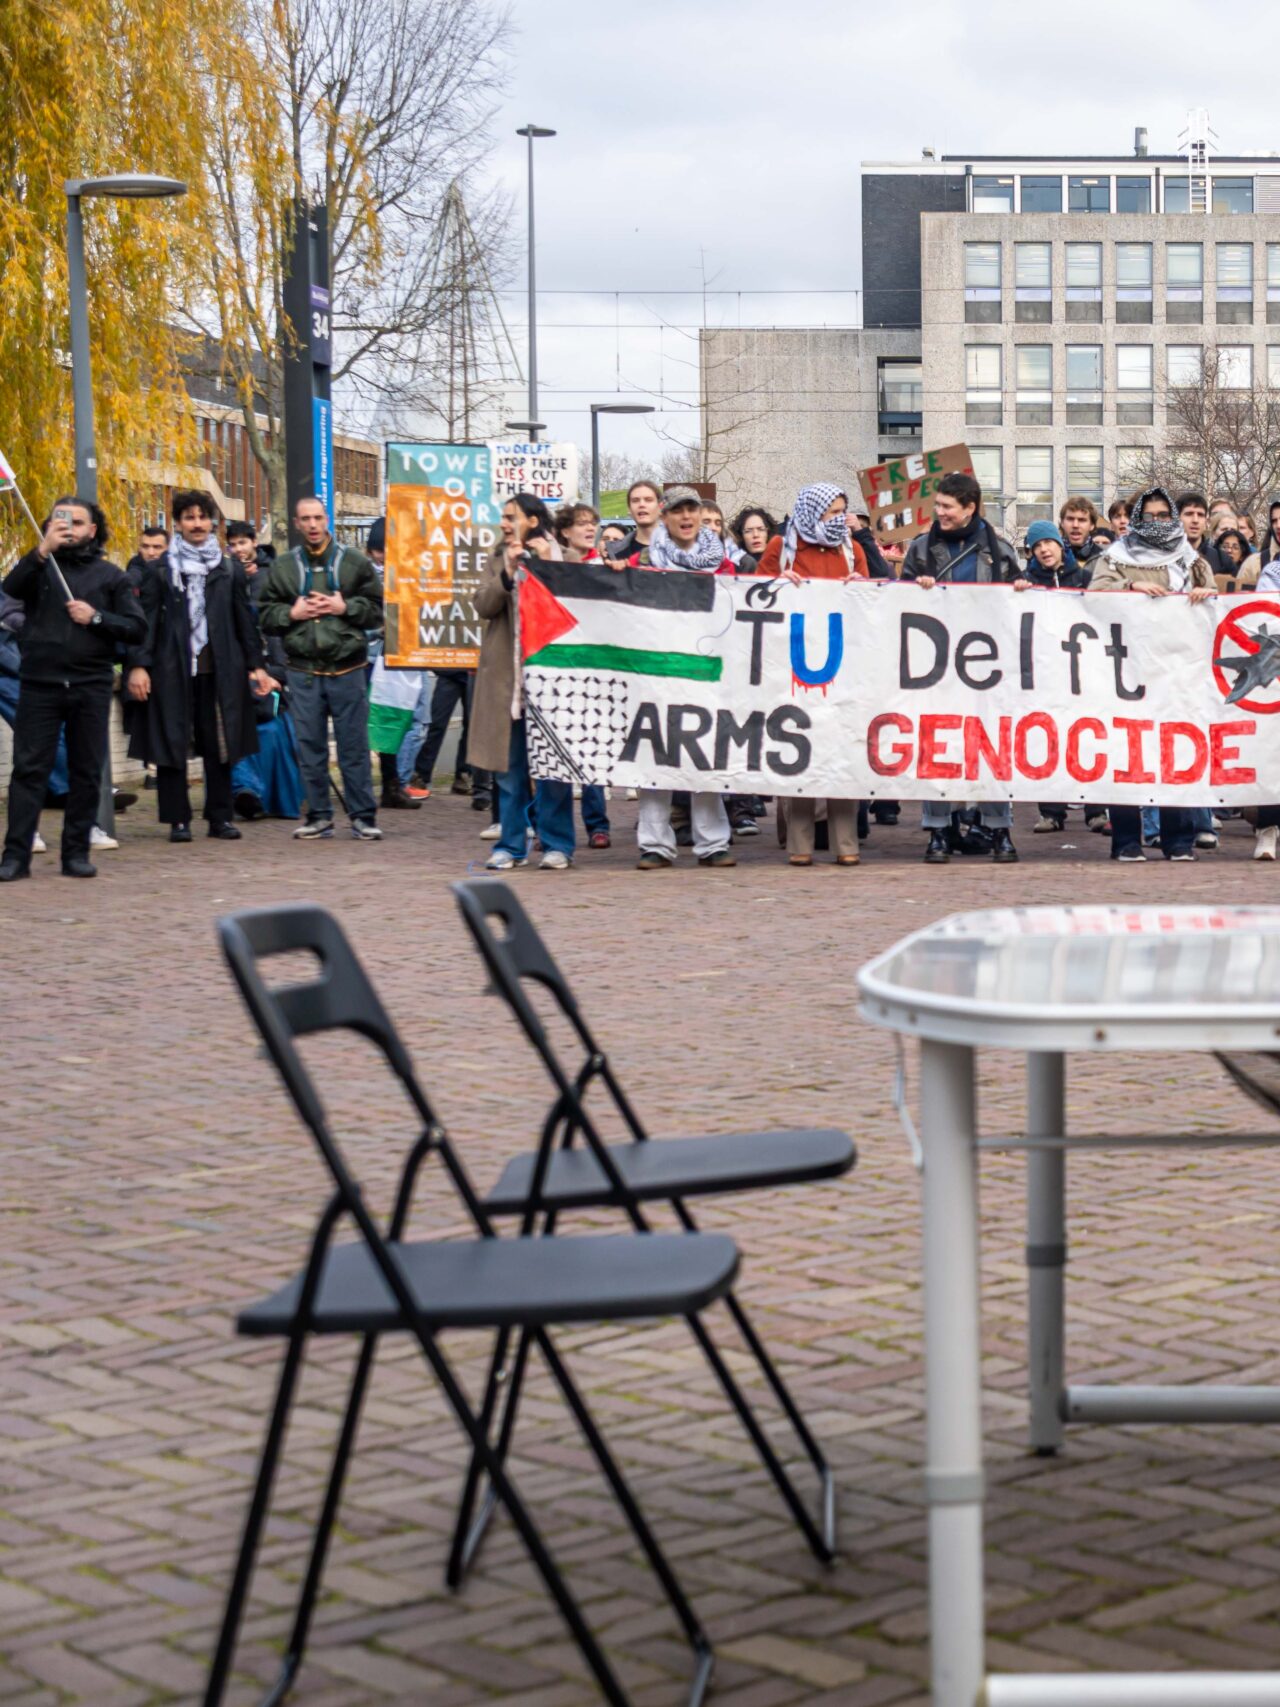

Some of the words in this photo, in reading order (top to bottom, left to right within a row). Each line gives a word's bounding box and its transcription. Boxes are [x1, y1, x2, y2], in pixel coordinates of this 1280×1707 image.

[312, 312, 329, 340] 34
[496, 445, 511, 454] TU
[402, 452, 487, 473] TOWE
[532, 457, 567, 470] THESE
[867, 450, 943, 491] FREE
[532, 470, 558, 481] CUT
[444, 477, 484, 497] OF
[496, 481, 525, 495] THE
[532, 482, 563, 498] TIES
[866, 484, 904, 510] THE
[417, 502, 502, 523] IVOR
[883, 507, 912, 531] THE
[429, 526, 496, 548] AND
[420, 551, 488, 572] STEE
[420, 625, 482, 646] WIN
[735, 610, 844, 692] TU
[900, 612, 1146, 701] Delft
[618, 702, 812, 777] ARMS
[867, 711, 1257, 786] GENOCIDE
